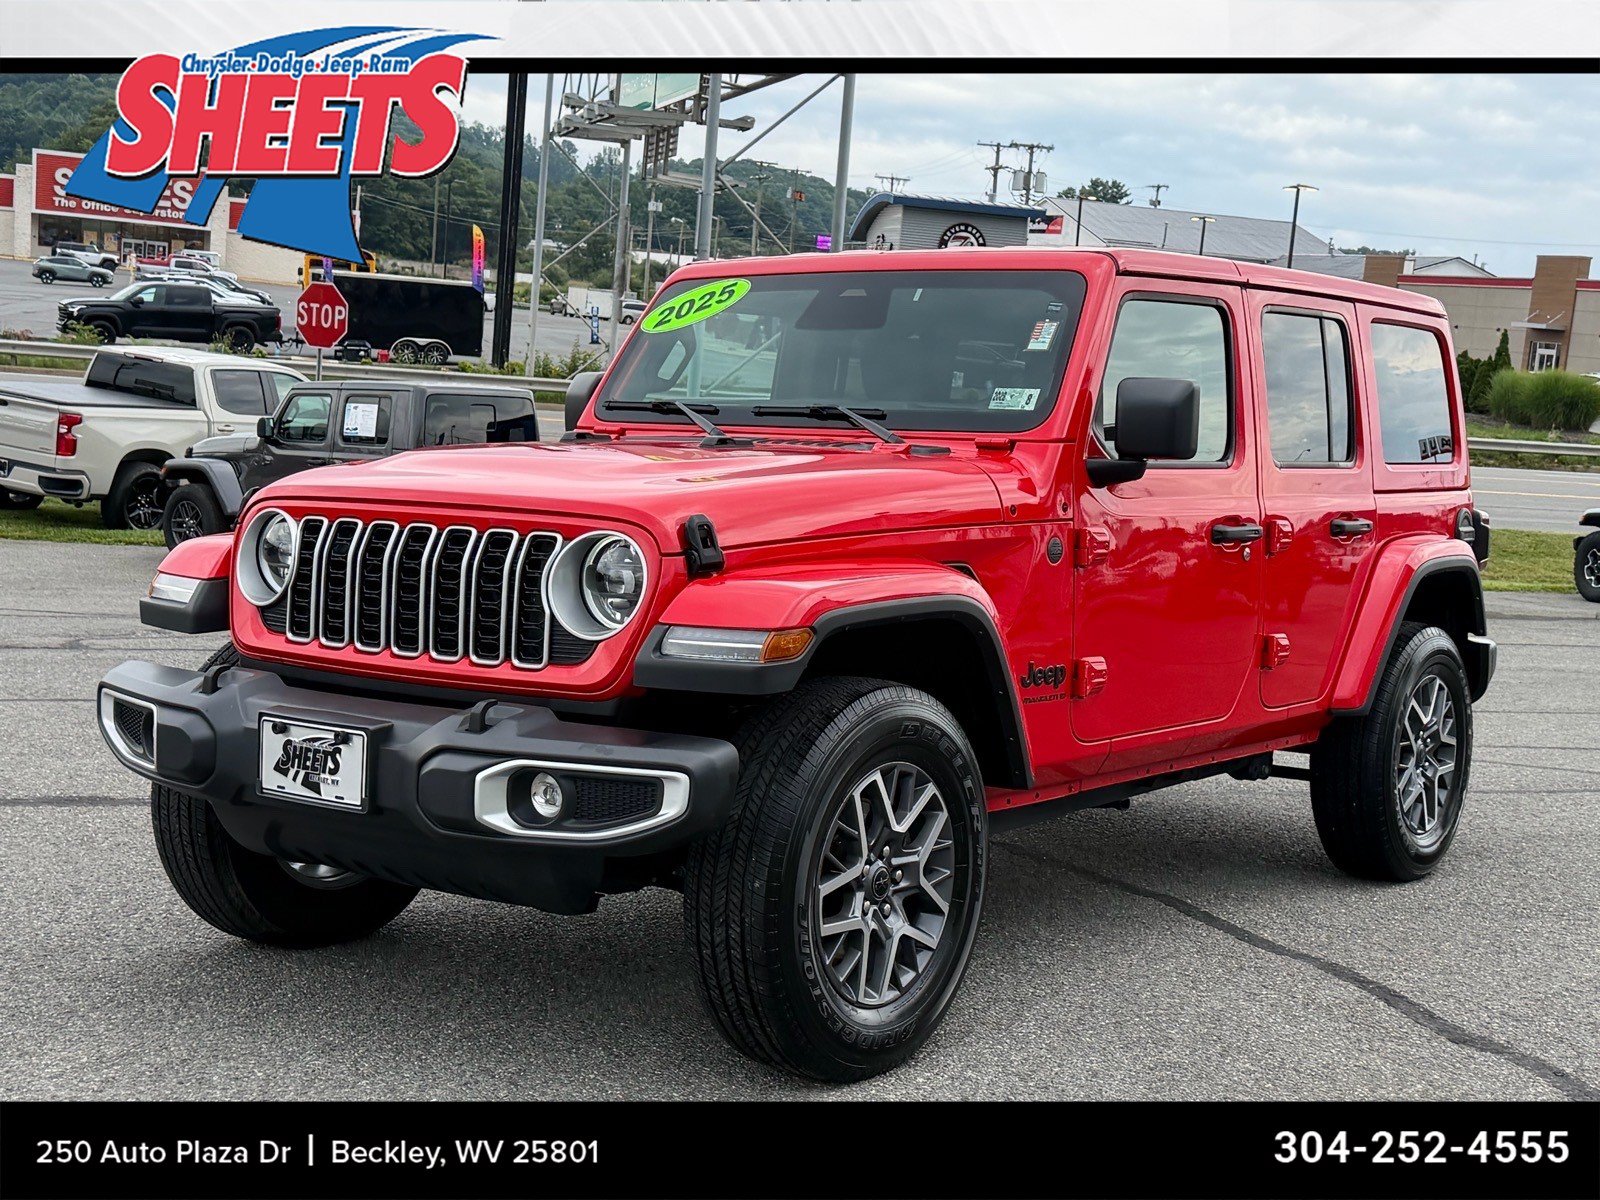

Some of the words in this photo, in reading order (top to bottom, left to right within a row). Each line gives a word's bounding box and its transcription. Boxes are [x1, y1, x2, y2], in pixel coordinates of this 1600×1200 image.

[53, 197, 77, 208] The
[297, 301, 346, 329] STOP
[652, 281, 739, 329] 2025
[1020, 660, 1067, 689] Jeep
[280, 738, 342, 776] SHEETS
